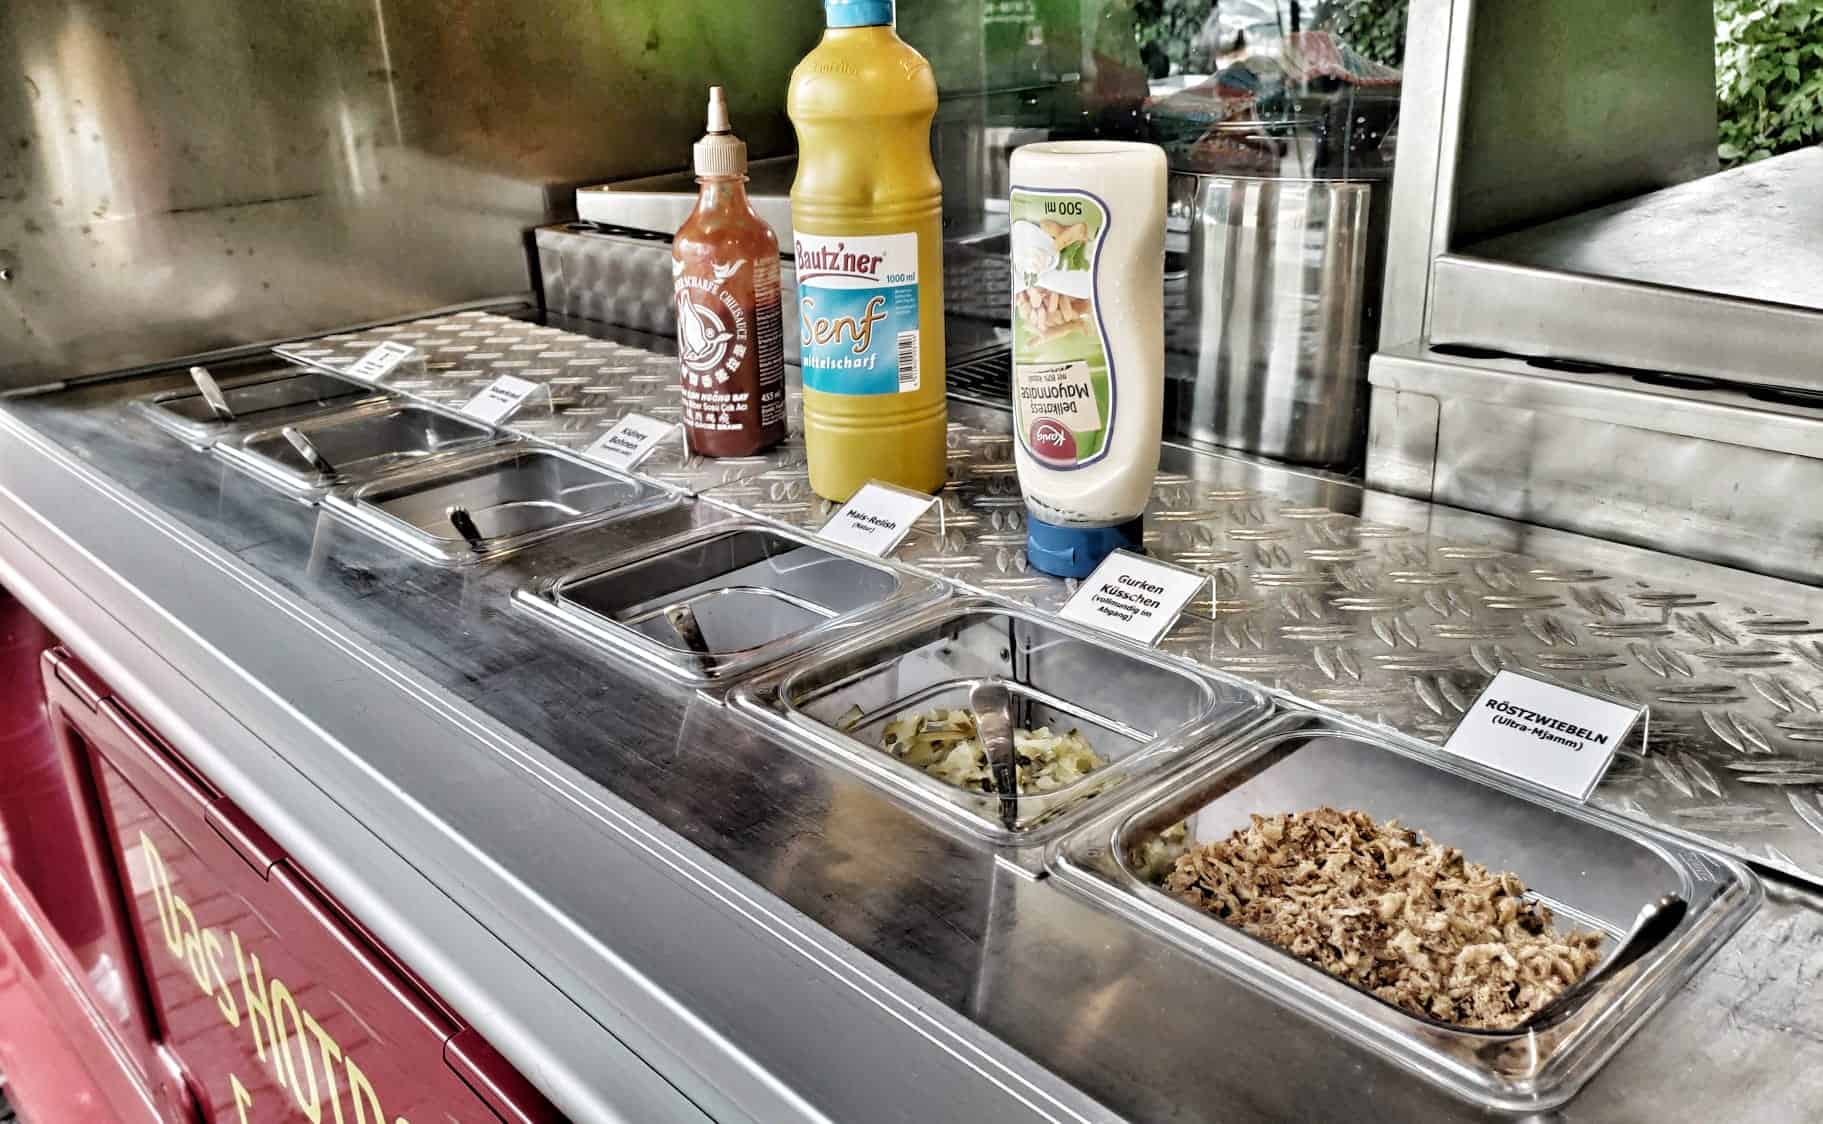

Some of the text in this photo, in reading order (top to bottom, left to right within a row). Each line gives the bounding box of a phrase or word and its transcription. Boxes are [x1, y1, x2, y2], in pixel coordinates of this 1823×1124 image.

[1044, 201, 1082, 215] 500 ml
[796, 239, 883, 274] Bautz'ner
[887, 272, 915, 283] 1000 ml
[801, 295, 888, 354] Senf
[803, 353, 878, 370] mittelscharf
[1020, 382, 1090, 400] Mayonnaise
[1030, 401, 1078, 416] Delikatess
[846, 509, 897, 530] Mais-Relish
[1118, 574, 1164, 595] Gurken
[1091, 593, 1153, 618] (vollmundig im
[1100, 583, 1161, 609] Küsschen
[1097, 605, 1134, 622] Abgang)
[1485, 698, 1608, 745] RÖSTZWIEBELN
[1491, 714, 1584, 752] (Ultra-Mjamm)
[231, 931, 410, 1124] HOTD
